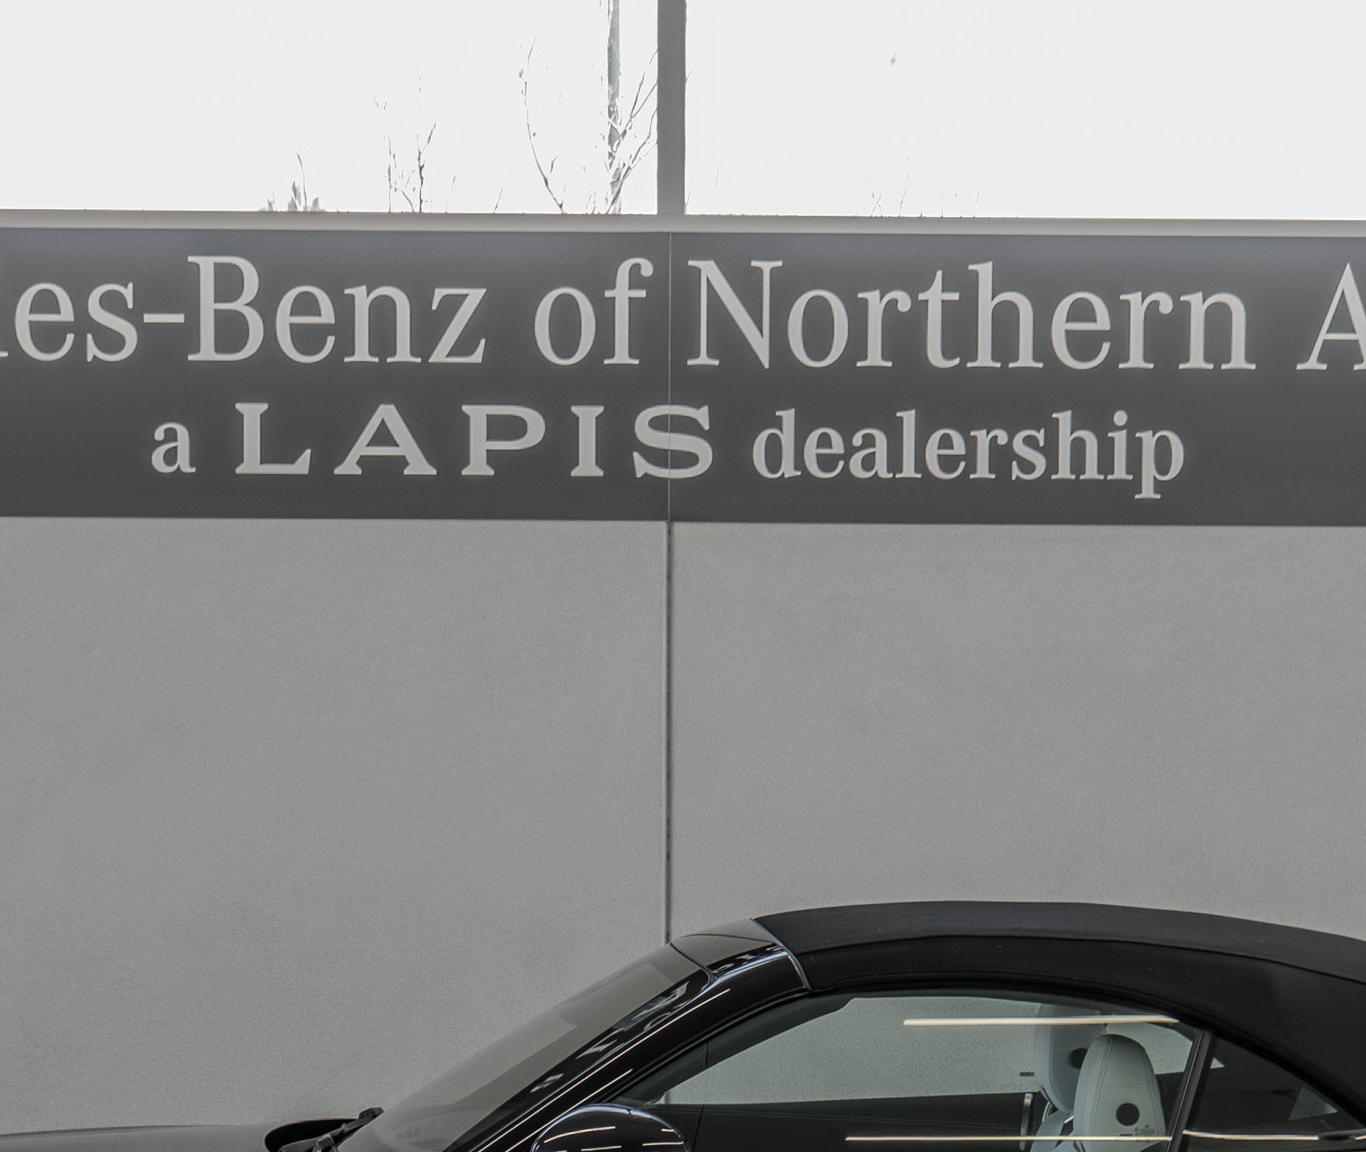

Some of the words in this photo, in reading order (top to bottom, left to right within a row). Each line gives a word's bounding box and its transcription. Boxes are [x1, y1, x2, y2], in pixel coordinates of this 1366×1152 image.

[534, 256, 656, 367] of
[686, 259, 1258, 370] Northern
[151, 422, 197, 475] a
[234, 402, 714, 480] LAPIS
[752, 407, 1186, 501] dealership
